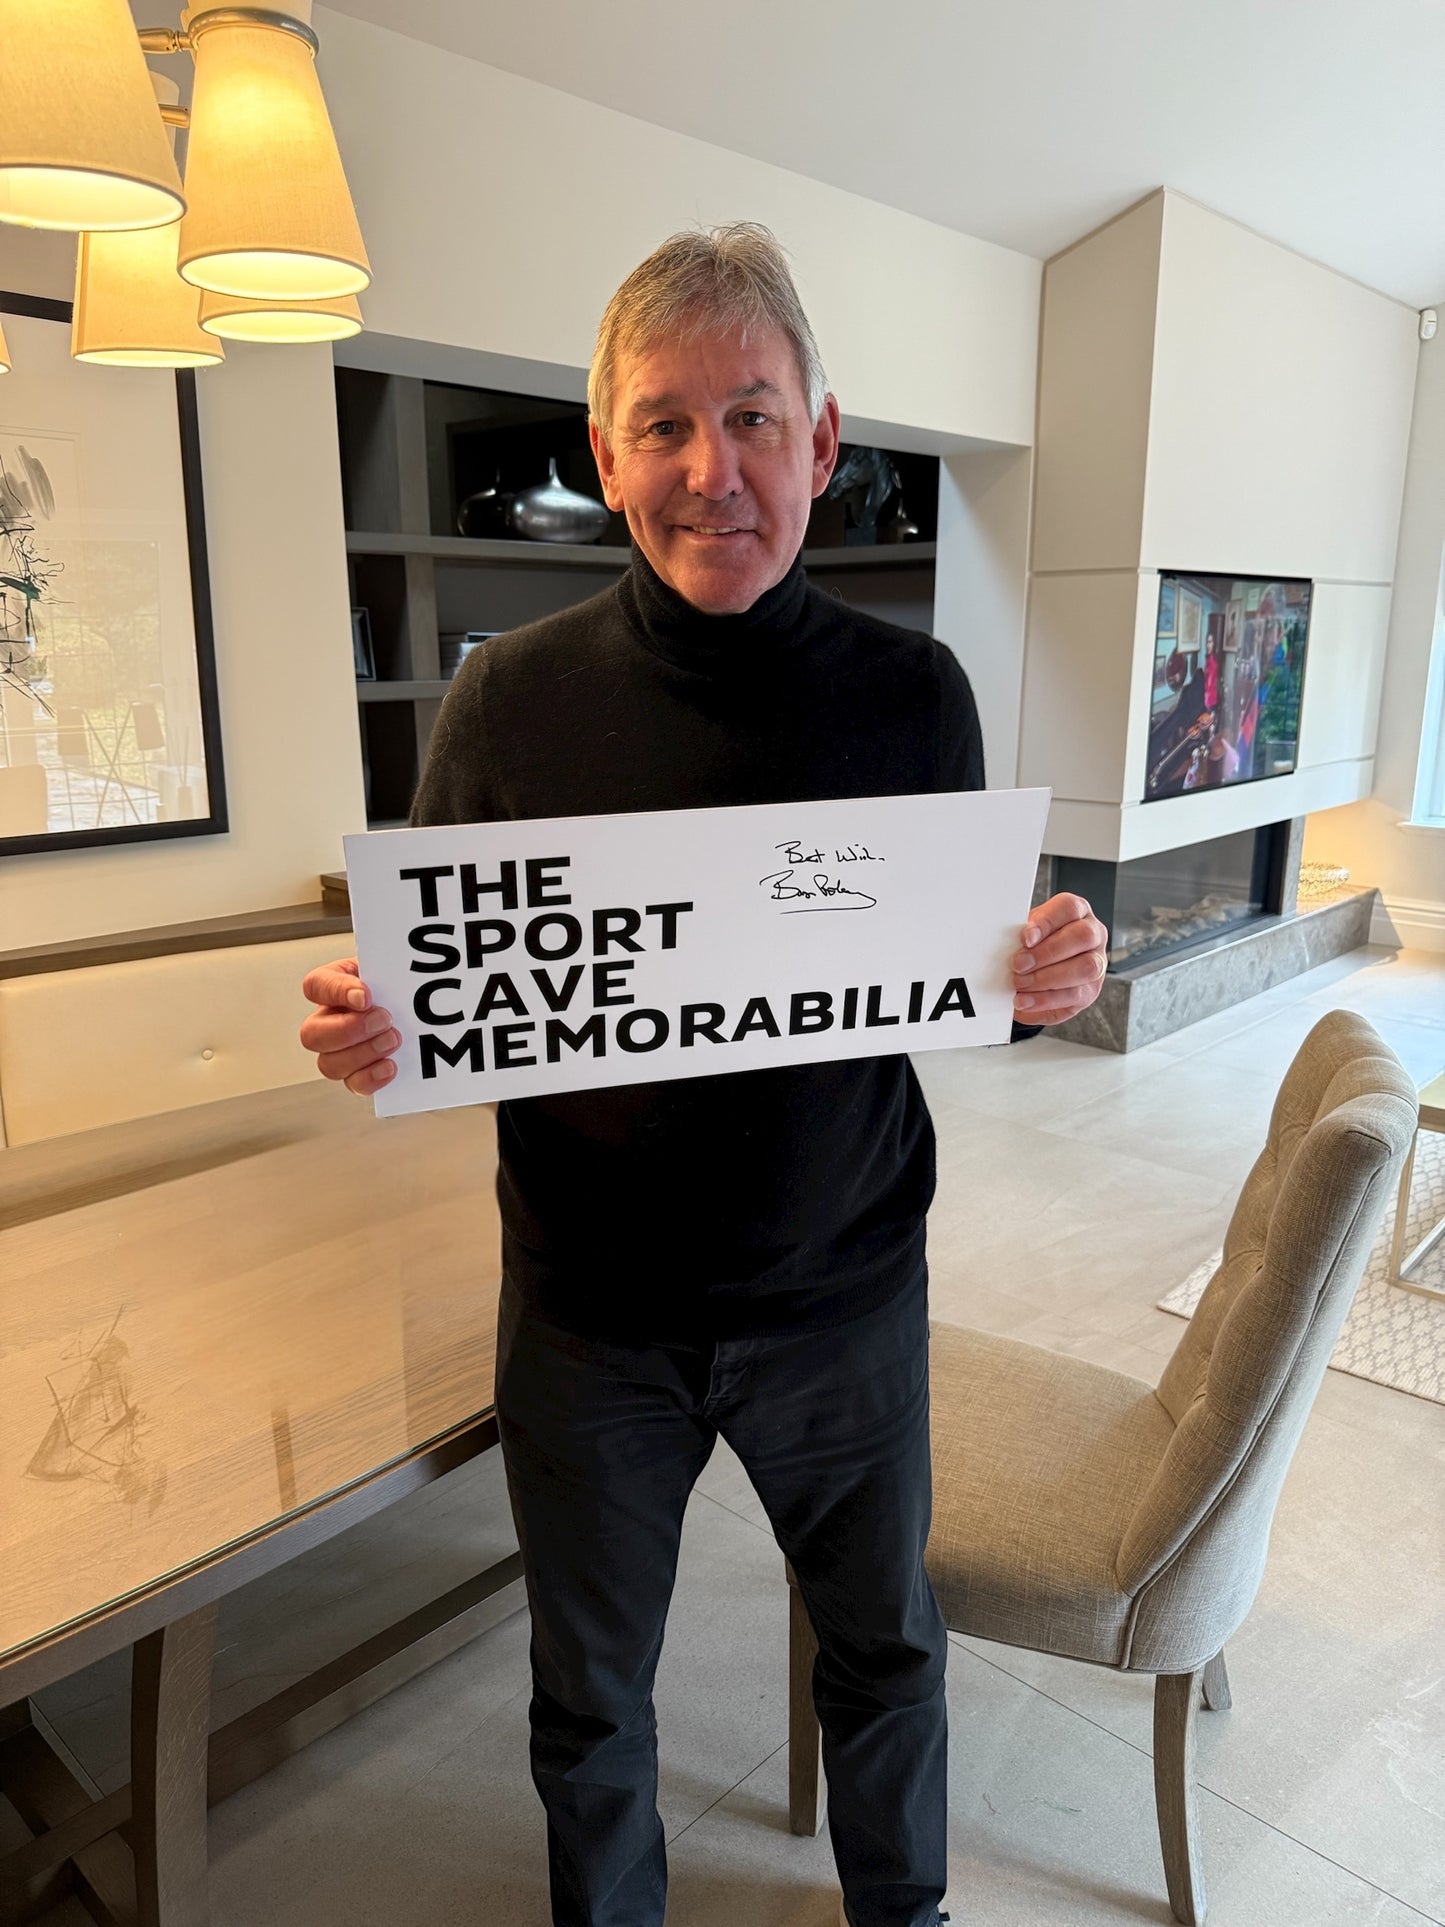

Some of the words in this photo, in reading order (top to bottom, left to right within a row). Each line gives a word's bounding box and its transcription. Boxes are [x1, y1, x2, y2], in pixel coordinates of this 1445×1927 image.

[400, 856, 572, 917] THE
[407, 901, 694, 974] SPORT
[412, 959, 635, 1026] CAVE
[418, 977, 977, 1080] MEMORABILIA
